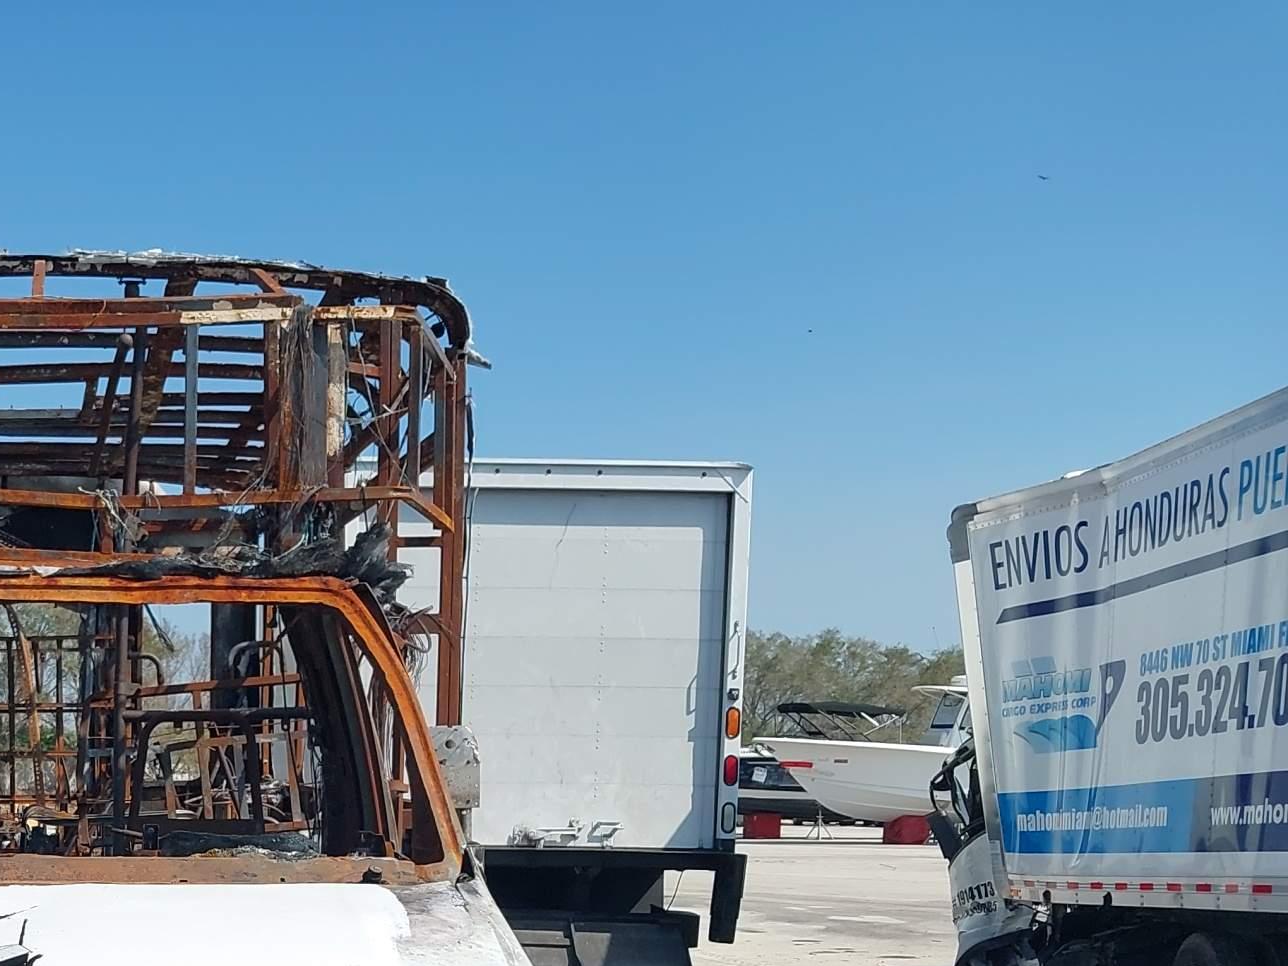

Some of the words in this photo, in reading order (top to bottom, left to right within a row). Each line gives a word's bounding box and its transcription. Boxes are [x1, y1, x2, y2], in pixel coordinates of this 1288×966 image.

[989, 520, 1089, 591] ENVIOS
[1099, 515, 1110, 568] A
[1114, 466, 1230, 563] HONDURAS
[1237, 445, 1288, 521] PUE
[1140, 647, 1168, 676] 8446
[1171, 642, 1194, 670] NW
[1196, 638, 1210, 665] 70
[1212, 633, 1229, 661] ST
[1230, 623, 1275, 658] MIAMI
[1002, 668, 1092, 703] MAHOMI
[1071, 696, 1097, 709] CORP
[1135, 652, 1288, 744] 305.324.70
